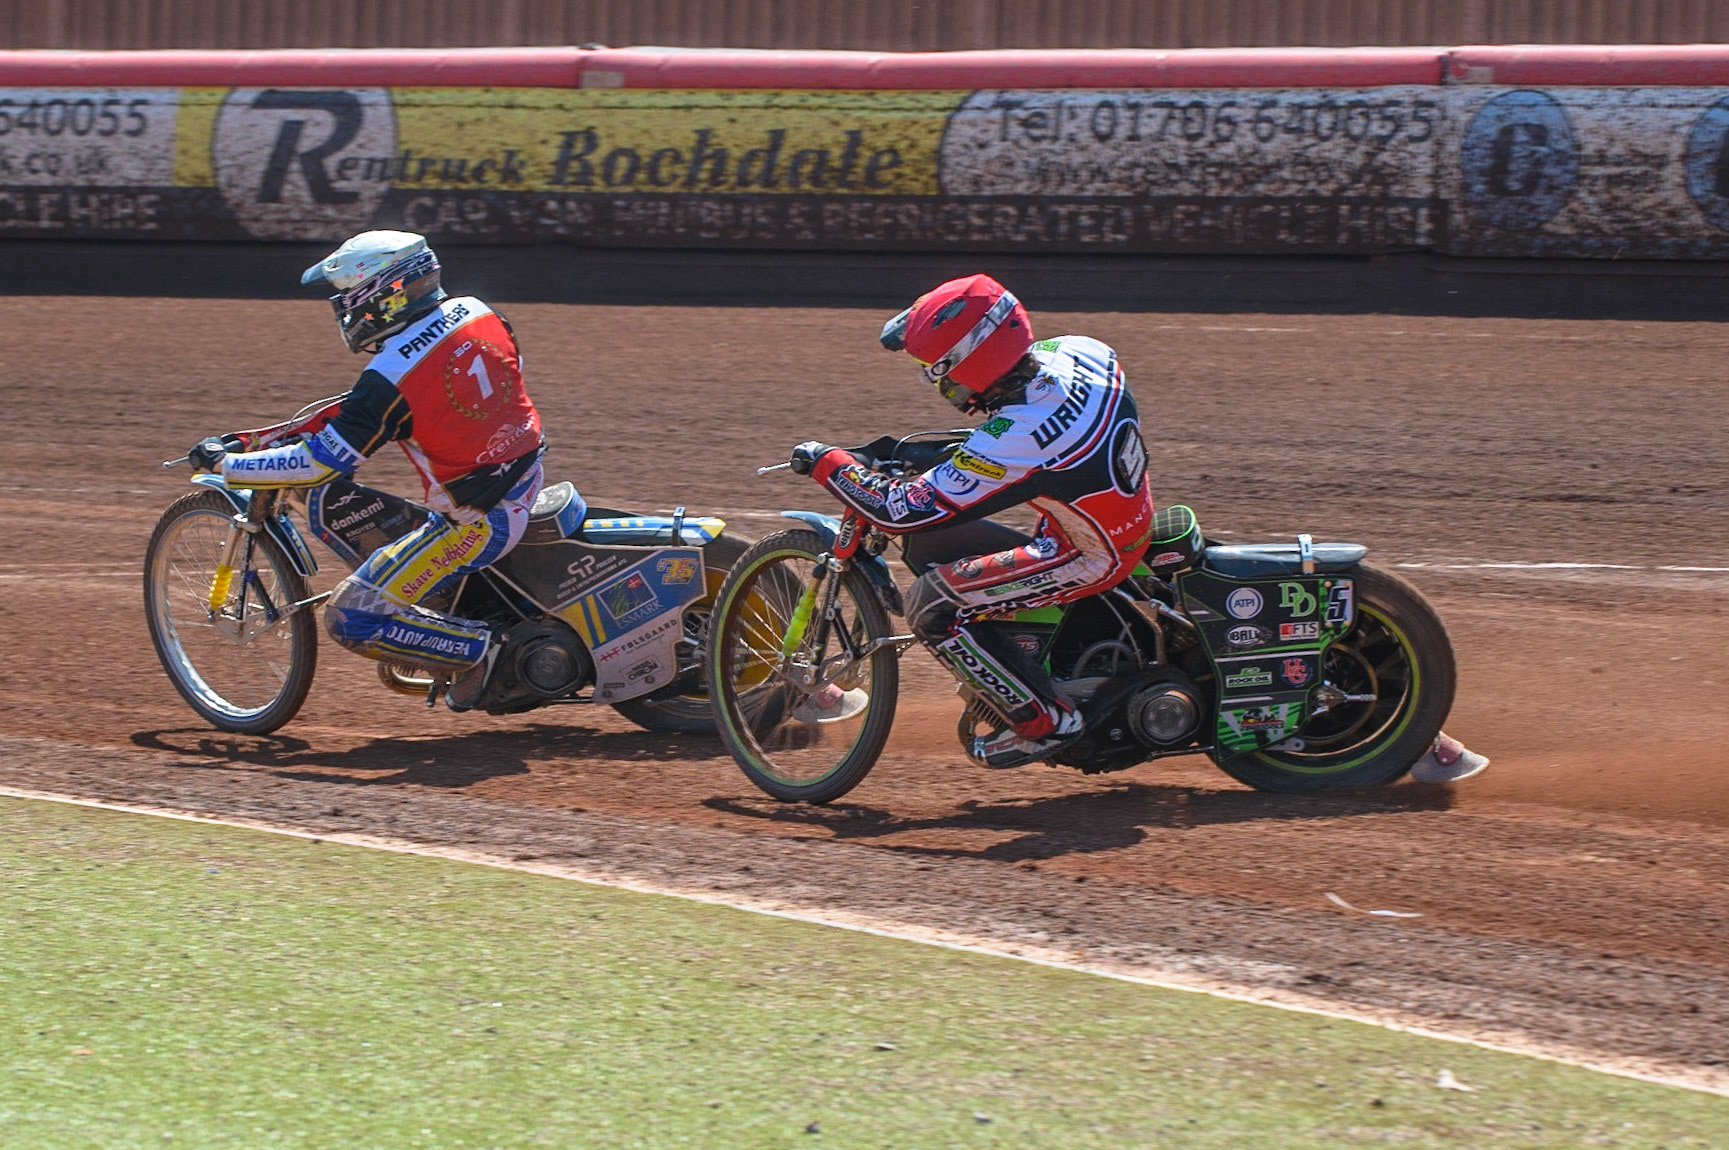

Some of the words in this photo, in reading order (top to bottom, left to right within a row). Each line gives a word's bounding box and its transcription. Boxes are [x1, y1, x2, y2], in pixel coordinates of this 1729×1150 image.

[250, 90, 525, 203] Rentruck
[547, 127, 902, 189] Rochdale
[466, 354, 494, 400] 1
[231, 455, 311, 472] METAROL
[331, 497, 385, 531] dankemi
[401, 568, 434, 599] Skave
[613, 599, 664, 629] ESMARK
[1293, 621, 1317, 635] FTS
[948, 639, 978, 668] OIL
[972, 667, 1024, 705] ROCK
